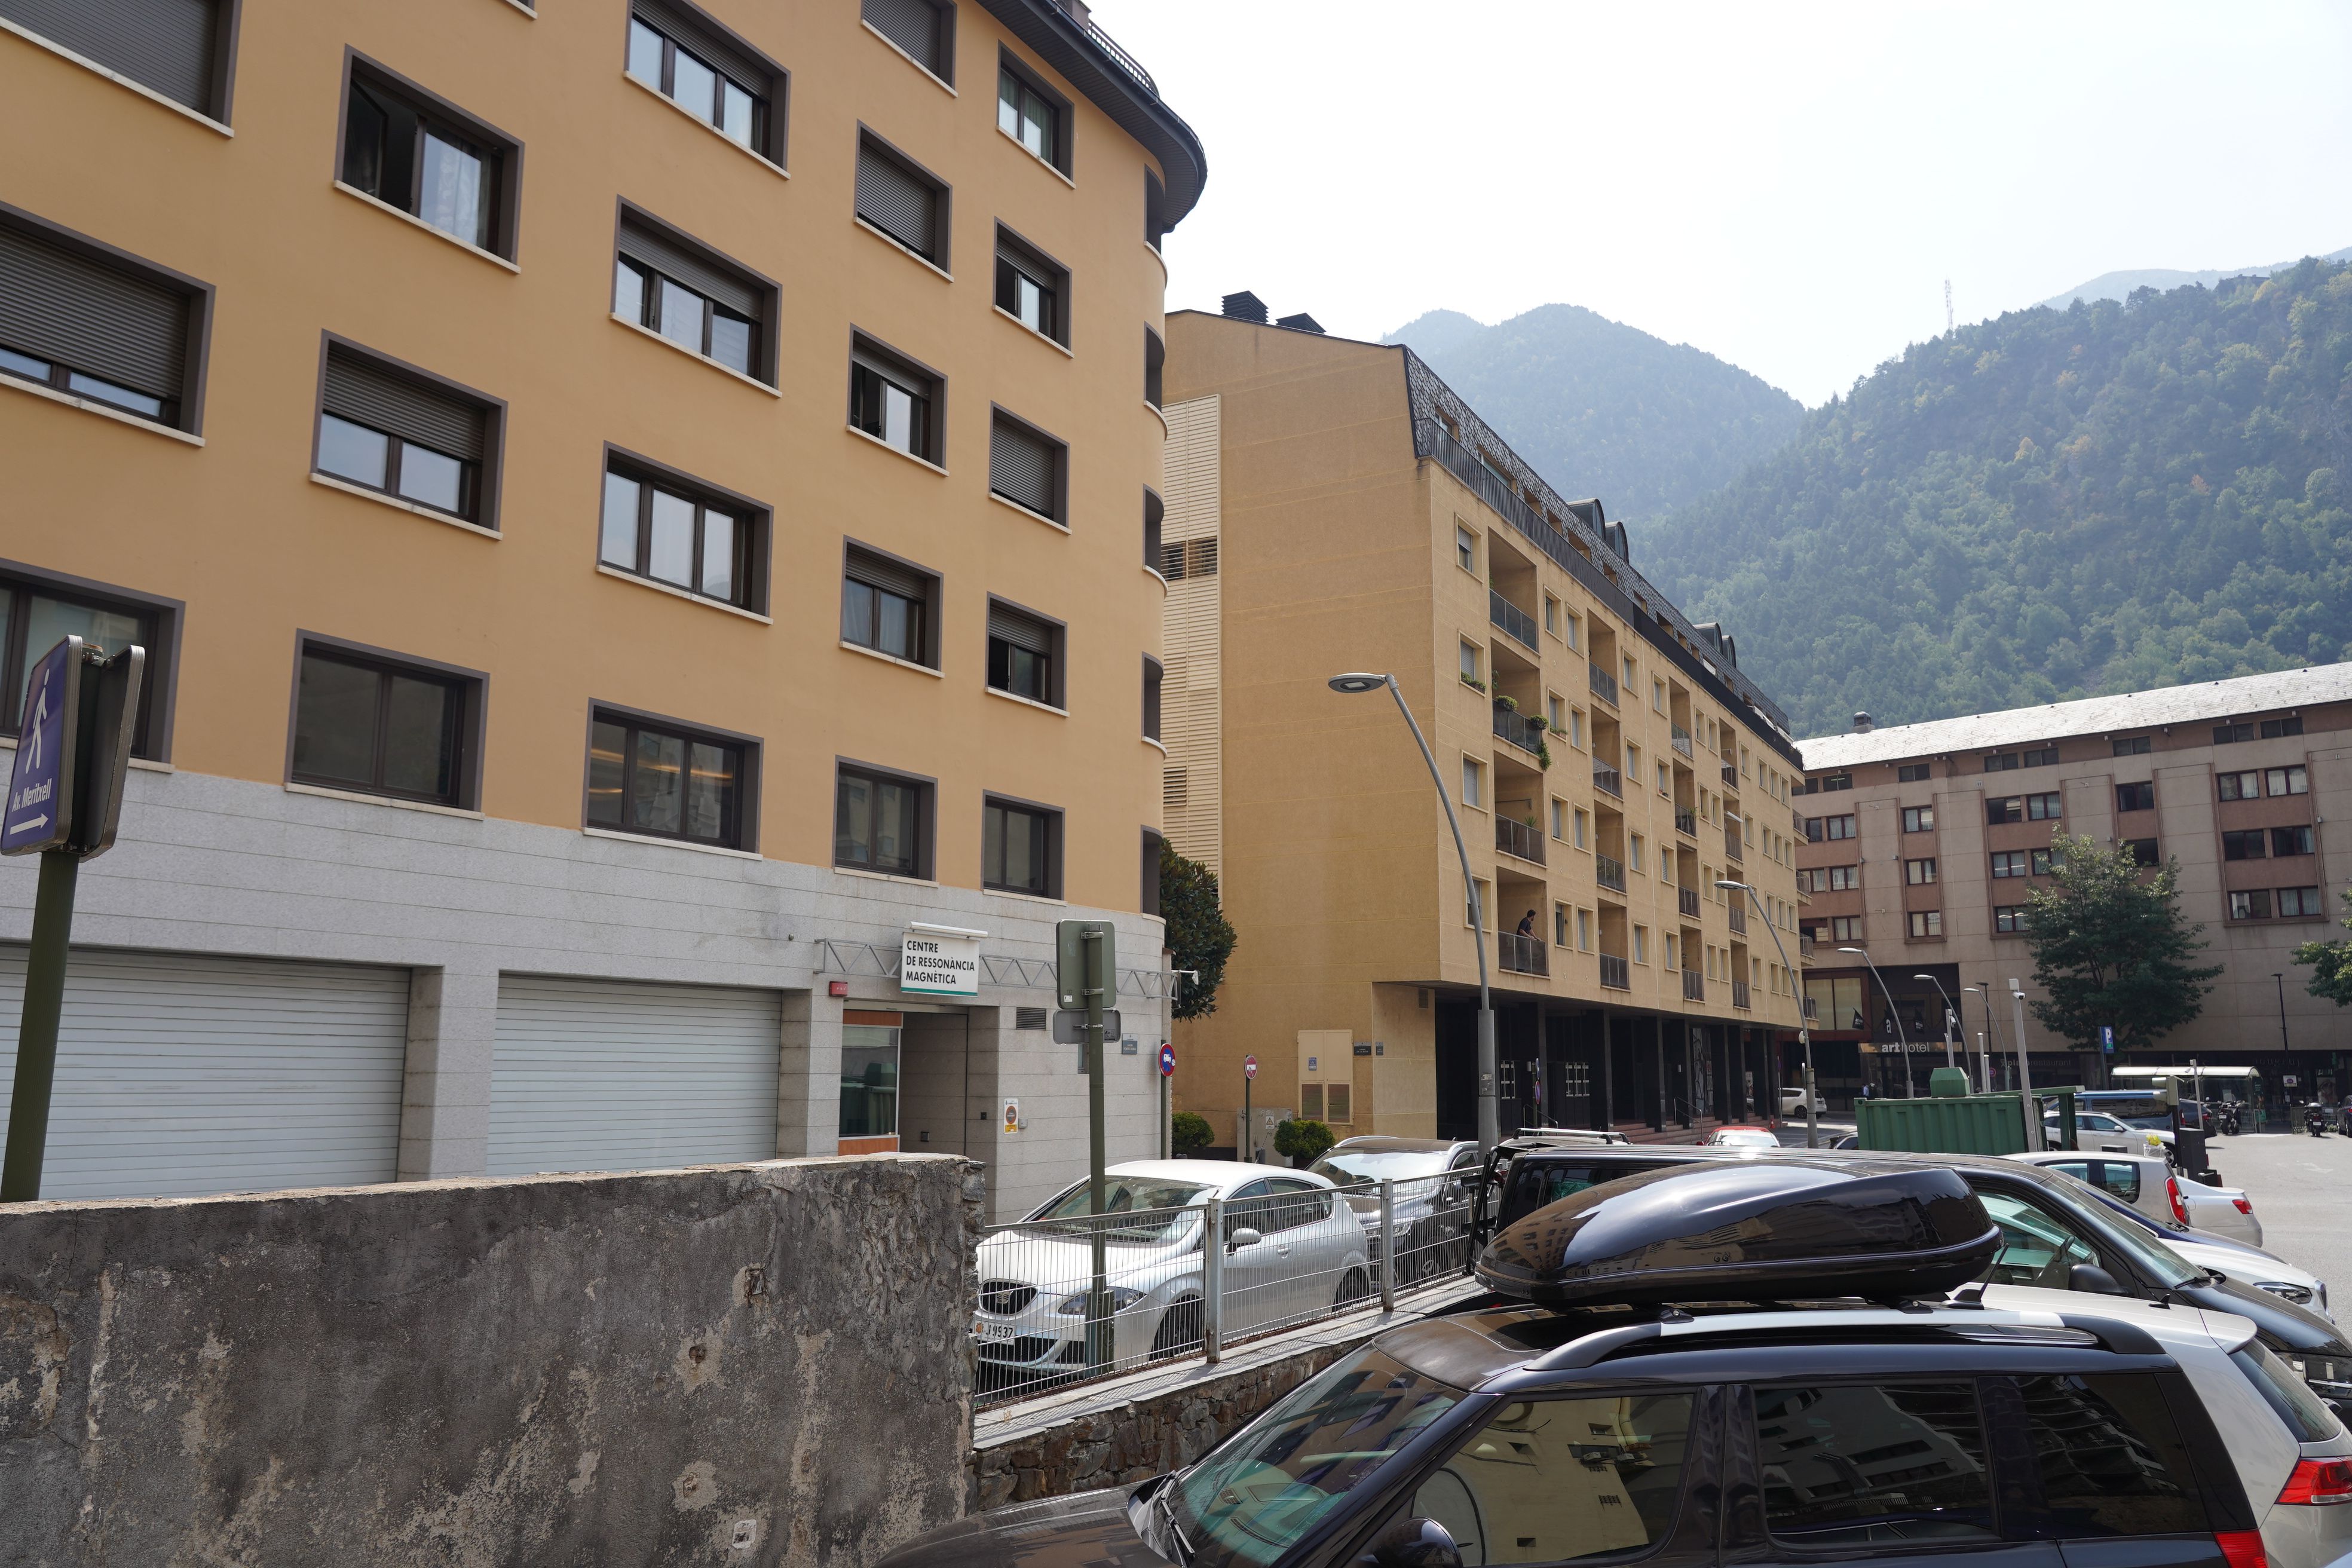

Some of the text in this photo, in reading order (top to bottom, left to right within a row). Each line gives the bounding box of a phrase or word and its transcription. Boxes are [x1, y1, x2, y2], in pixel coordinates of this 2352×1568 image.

[12, 778, 52, 812] Av. Meritxell
[907, 941, 938, 953] CENTRE
[906, 956, 975, 971] DE RESSONÀNCIA
[906, 970, 956, 985] MAGNÈTICA
[1886, 1019, 1892, 1034] a
